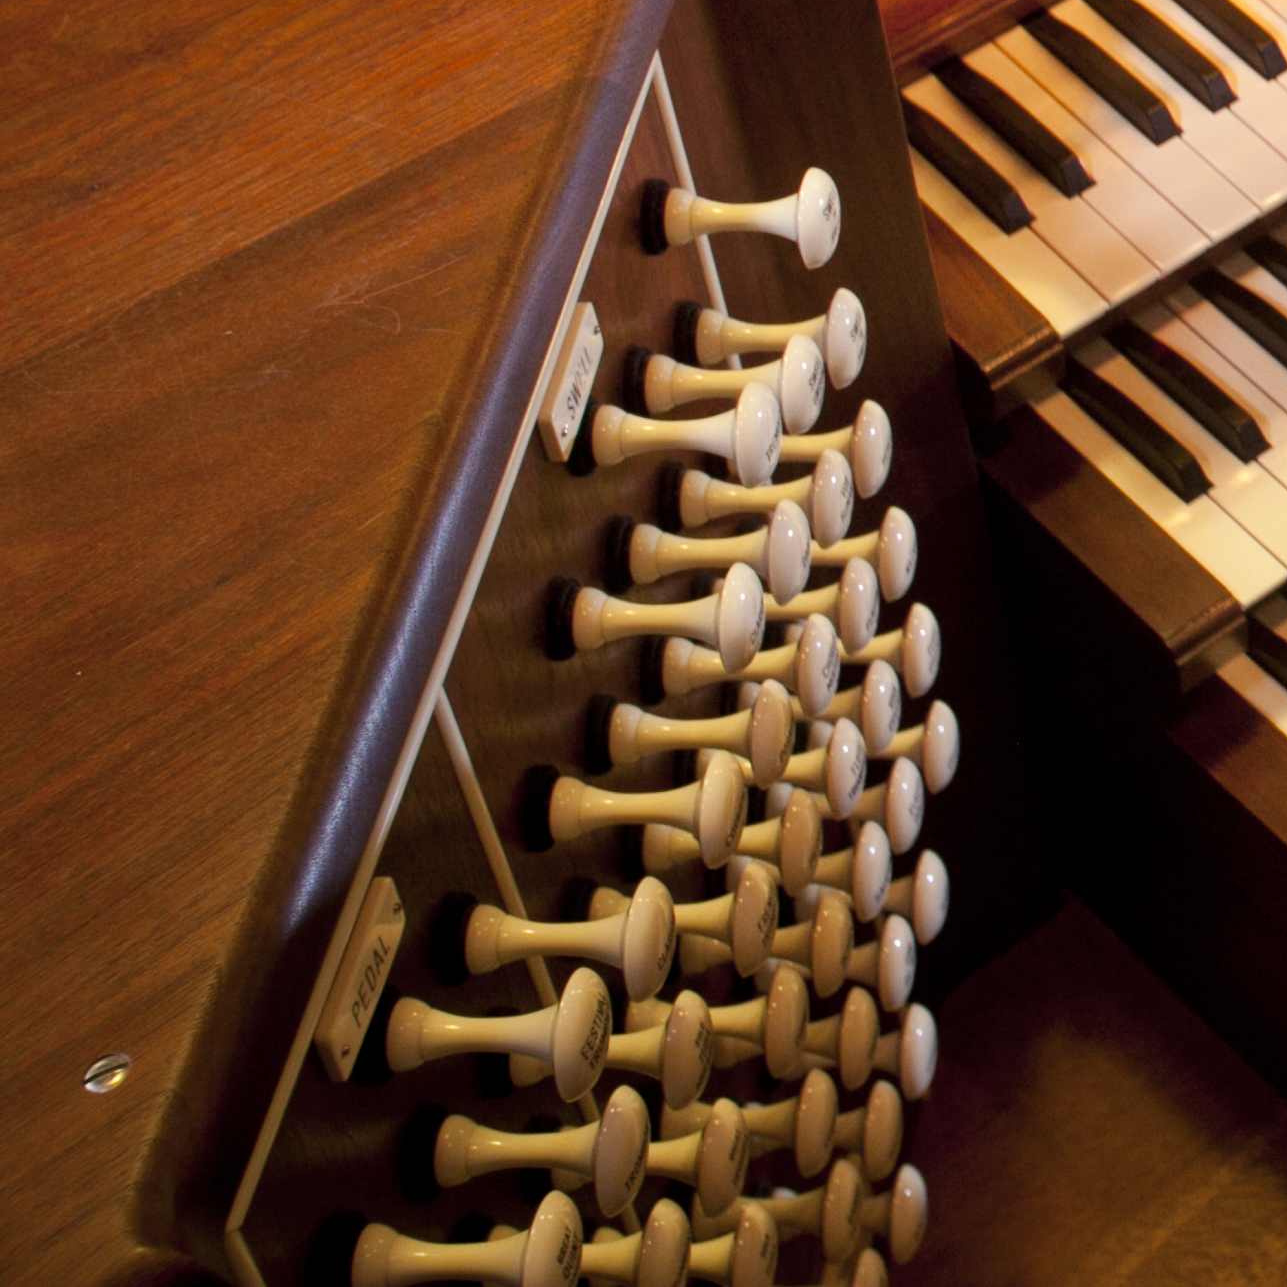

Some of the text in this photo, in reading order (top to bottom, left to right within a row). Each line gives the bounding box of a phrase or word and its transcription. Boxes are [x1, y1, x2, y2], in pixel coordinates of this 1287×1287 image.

[567, 345, 594, 421] SWELL
[352, 936, 390, 1030] PEDAL
[580, 991, 606, 1062] FESTIVAL
